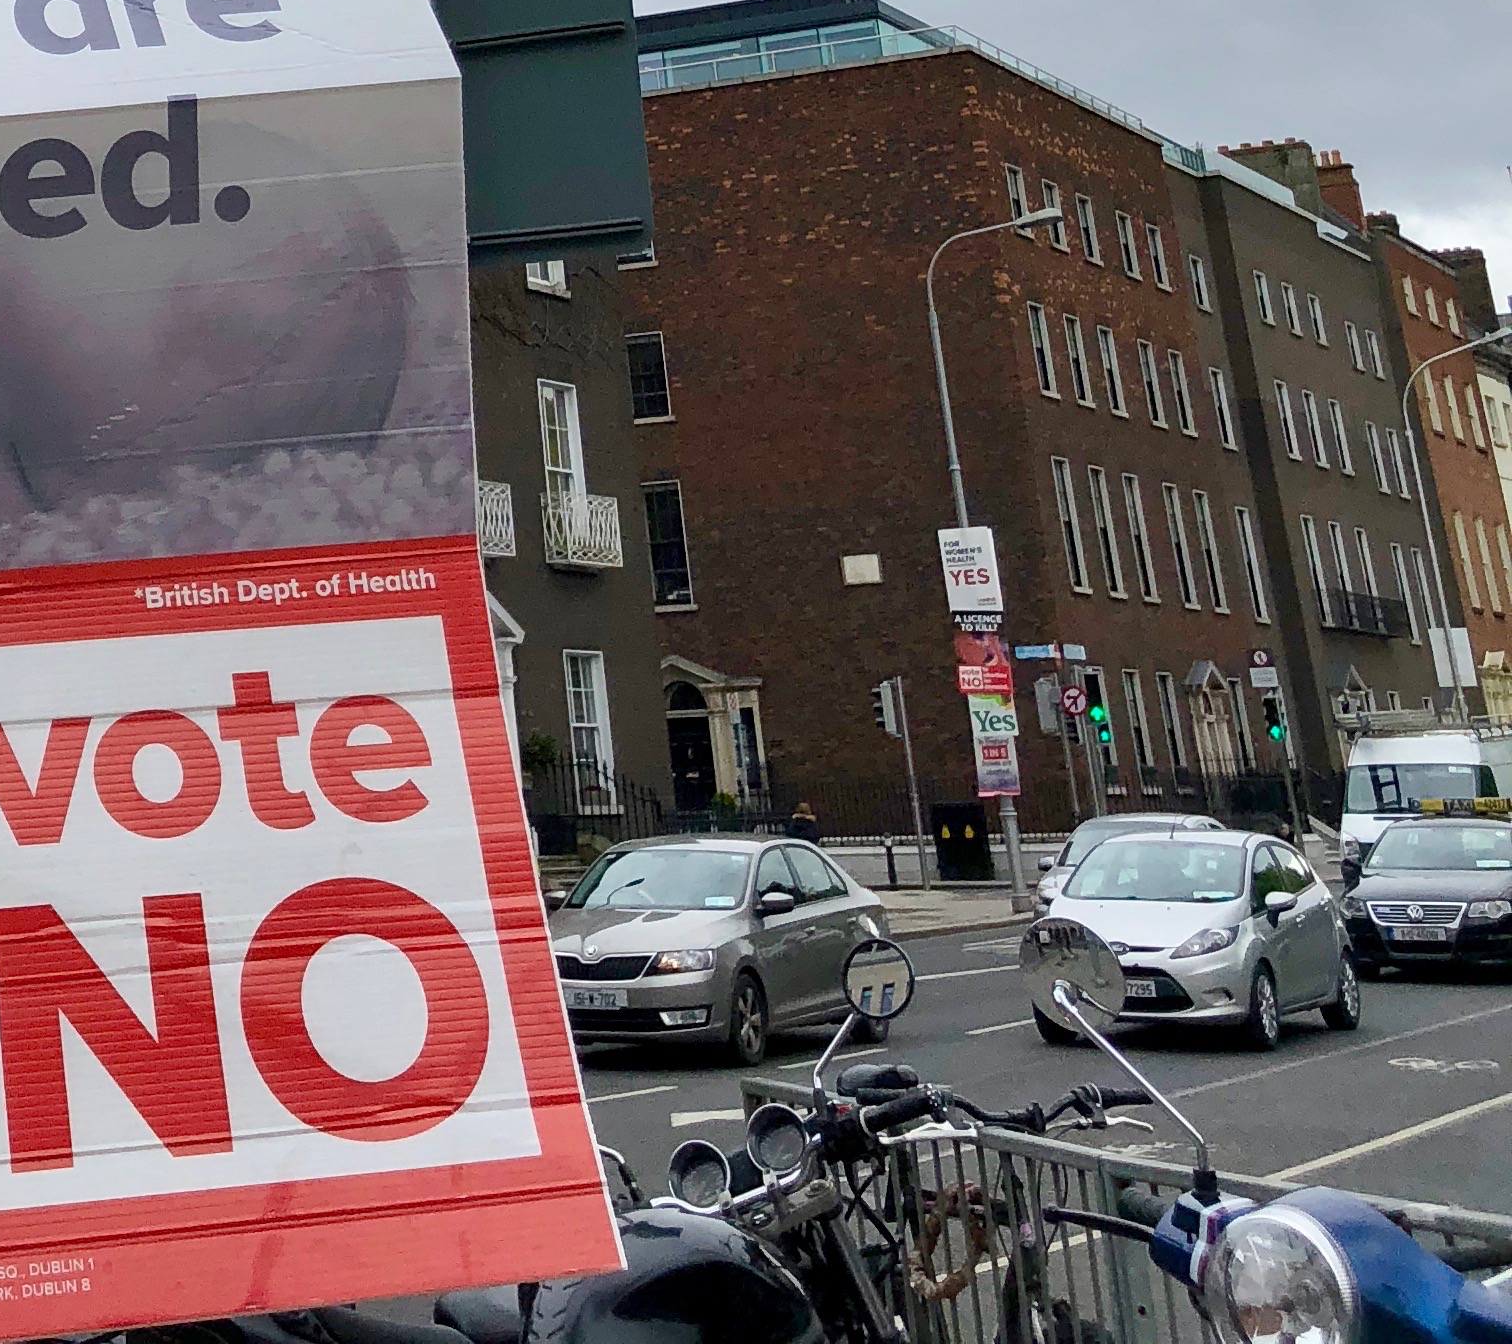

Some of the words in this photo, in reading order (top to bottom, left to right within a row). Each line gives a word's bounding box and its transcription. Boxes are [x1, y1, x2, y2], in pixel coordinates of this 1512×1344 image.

[943, 540, 960, 548] FOR
[945, 555, 975, 564] HEALTH
[948, 567, 990, 586] YES
[237, 578, 308, 605] Dept.
[316, 573, 340, 596] of
[348, 568, 436, 594] Health
[954, 614, 962, 623] A
[963, 614, 1003, 624] LICENCE
[960, 623, 973, 632] TO
[961, 676, 982, 688] NO
[971, 710, 1016, 733] Yes
[29, 1258, 85, 1276] DUBLIN
[87, 1257, 95, 1271] 1
[21, 1279, 77, 1298] DUBLIN
[81, 1277, 91, 1292] 8
